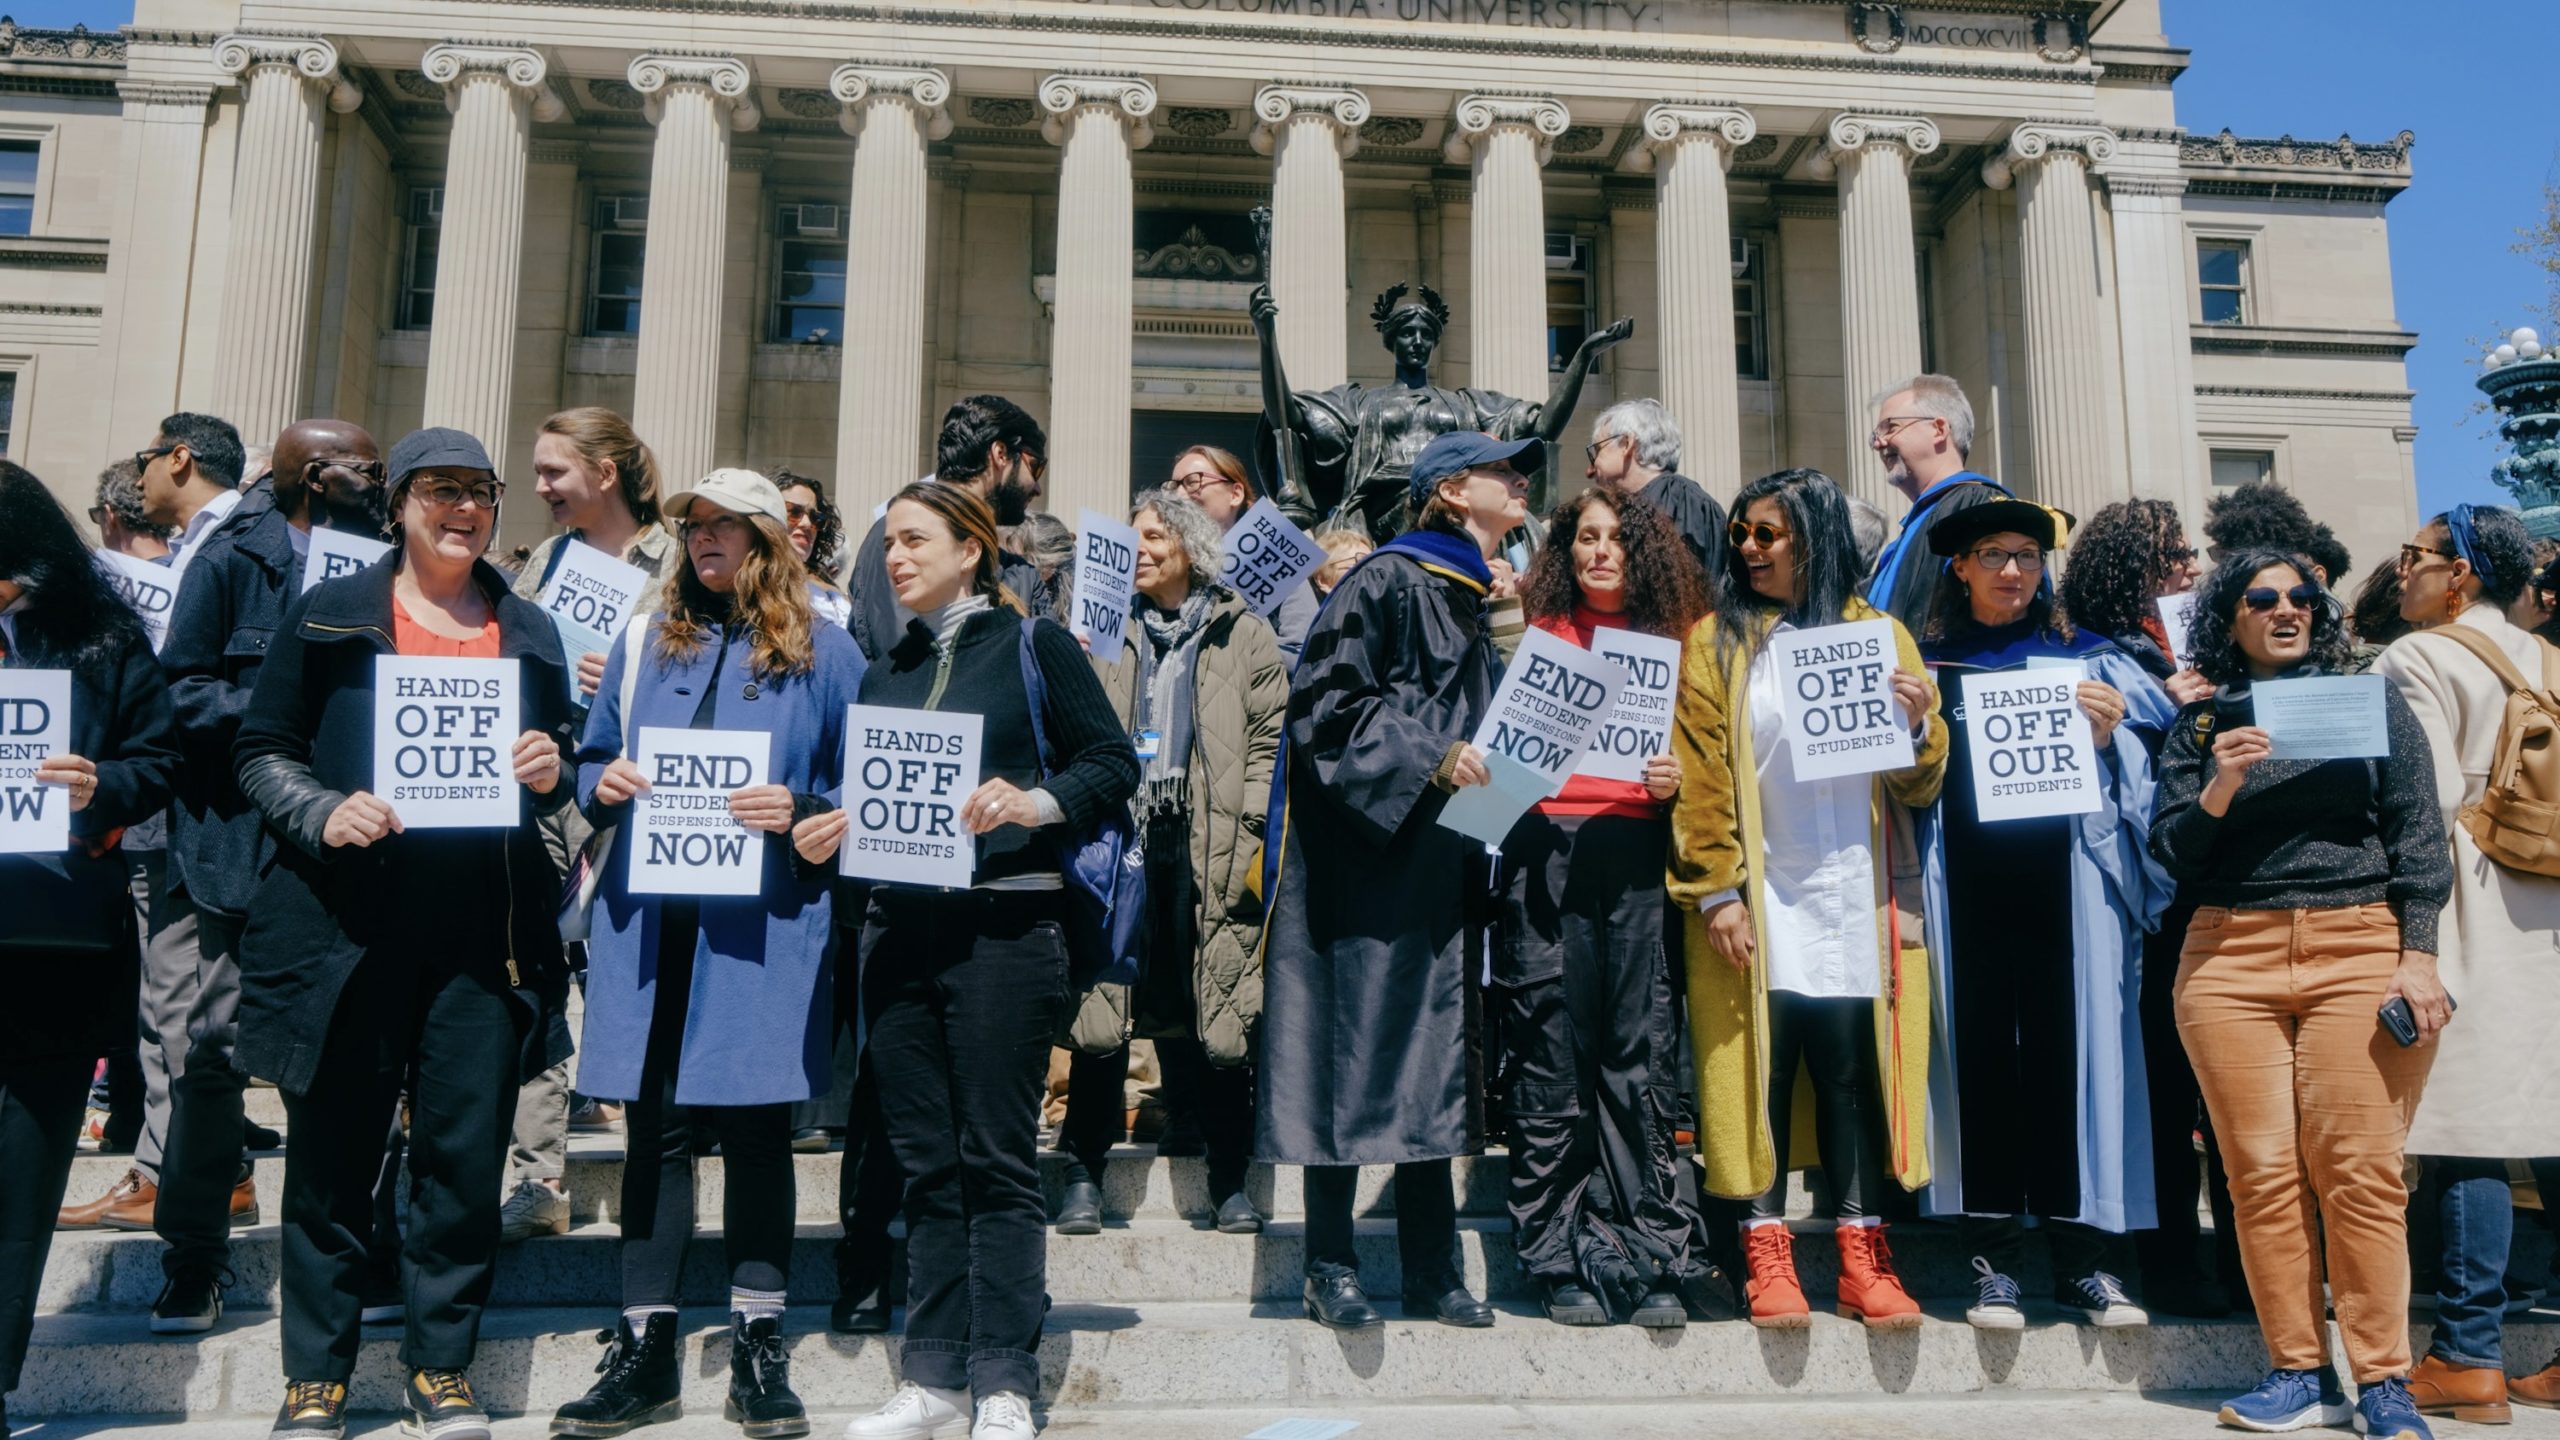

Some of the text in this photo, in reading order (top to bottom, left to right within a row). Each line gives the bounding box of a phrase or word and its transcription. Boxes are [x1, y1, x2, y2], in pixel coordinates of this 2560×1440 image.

[1398, 0, 1646, 32] UNIVERSITY
[1909, 25, 2027, 50] MDCCCXCVII
[1086, 532, 1131, 575] END
[1238, 533, 1297, 582] OFF
[1253, 516, 1310, 567] HANDS
[564, 569, 628, 605] FACULTY
[1084, 566, 1128, 594] STUDENT
[1221, 553, 1274, 604] OUR
[550, 584, 617, 636] FOR
[1082, 599, 1123, 639] NOW
[1792, 638, 1880, 667] HANDS
[396, 677, 500, 699] HANDS
[1519, 653, 1606, 711] END
[1797, 662, 1883, 702] OFF
[1980, 685, 2070, 709] HANDS
[1510, 688, 1591, 731] STUDENT
[1618, 692, 1668, 711] UDENT
[1803, 698, 1892, 736] OUR
[395, 704, 500, 738] OFF
[1503, 706, 1582, 745] SUSPENSIONS
[1984, 708, 2072, 743] OFF
[864, 728, 963, 755] HANDS
[1487, 721, 1573, 773] NOW
[1589, 724, 1664, 758] NOW
[1807, 733, 1895, 756] STUDENTS
[395, 745, 500, 779] OUR
[652, 753, 752, 789] END
[862, 757, 961, 796] OFF
[1989, 744, 2080, 778] OUR
[394, 786, 500, 799] STUDENTS
[650, 793, 730, 811] STUDE
[1992, 778, 2082, 797] STUDENTS
[860, 798, 956, 838] OUR
[646, 832, 748, 867] NOW
[858, 837, 955, 859] STUDENTS
